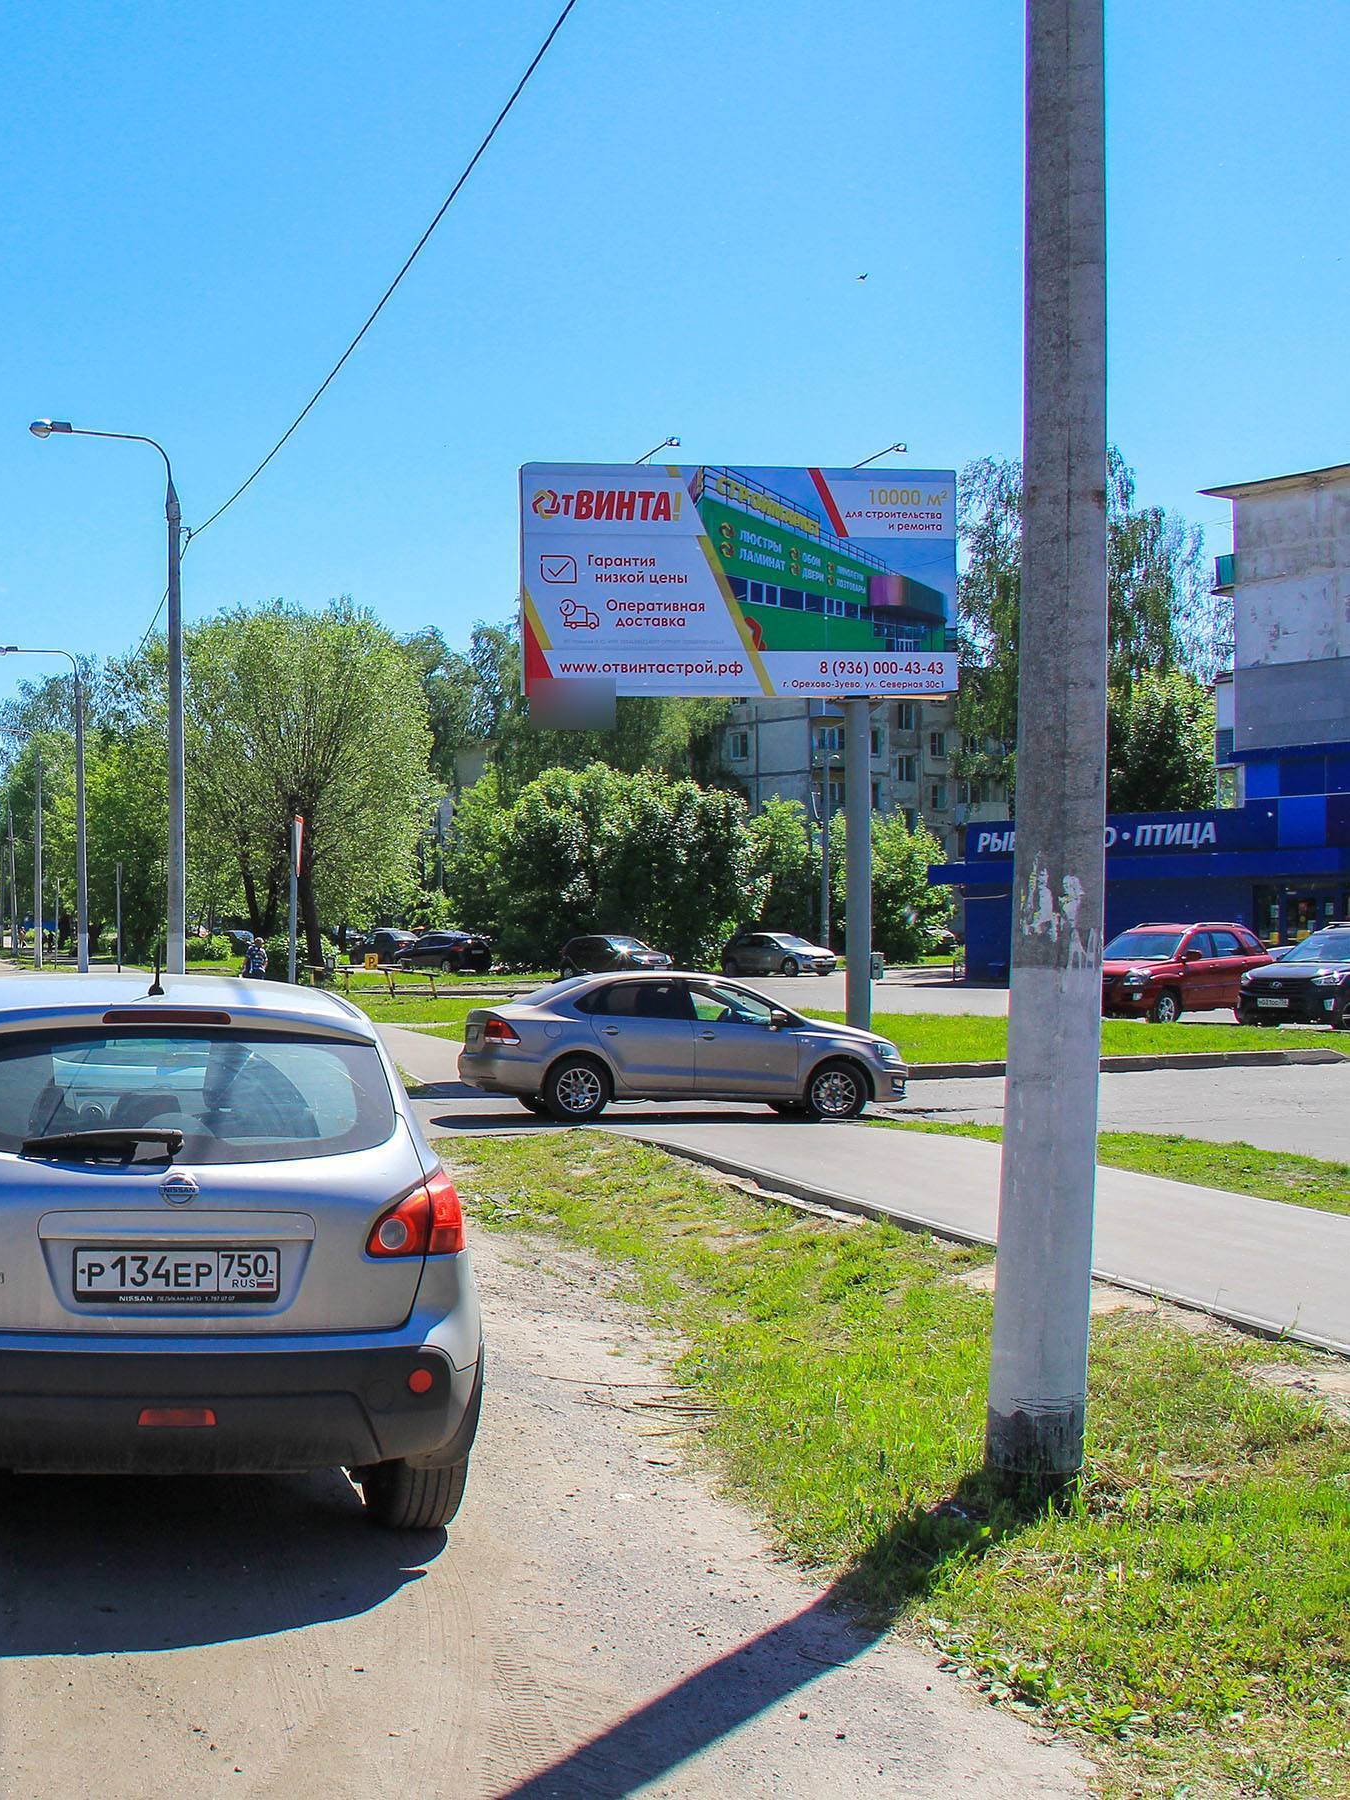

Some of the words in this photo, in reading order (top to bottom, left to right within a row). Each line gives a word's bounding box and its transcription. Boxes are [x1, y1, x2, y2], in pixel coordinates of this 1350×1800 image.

[869, 488, 921, 506] 10000
[845, 510, 863, 518] для
[865, 510, 942, 520] строительства
[897, 523, 943, 532] ремонта
[587, 554, 656, 569] Гарантия
[595, 570, 645, 583] низкой
[649, 573, 688, 585] цены
[606, 599, 706, 614] Оперативная
[615, 617, 686, 628] доставка
[559, 660, 744, 676] www.отвинтастрой.рф
[819, 661, 828, 674] 8
[832, 661, 869, 676] (936)
[873, 661, 944, 675] 000-43-43
[879, 680, 923, 689] Северная
[1135, 822, 1217, 849] ПТИЦА
[87, 1255, 213, 1288] Р134ЕР
[220, 1254, 269, 1278] 750
[232, 1279, 256, 1288] RUS
